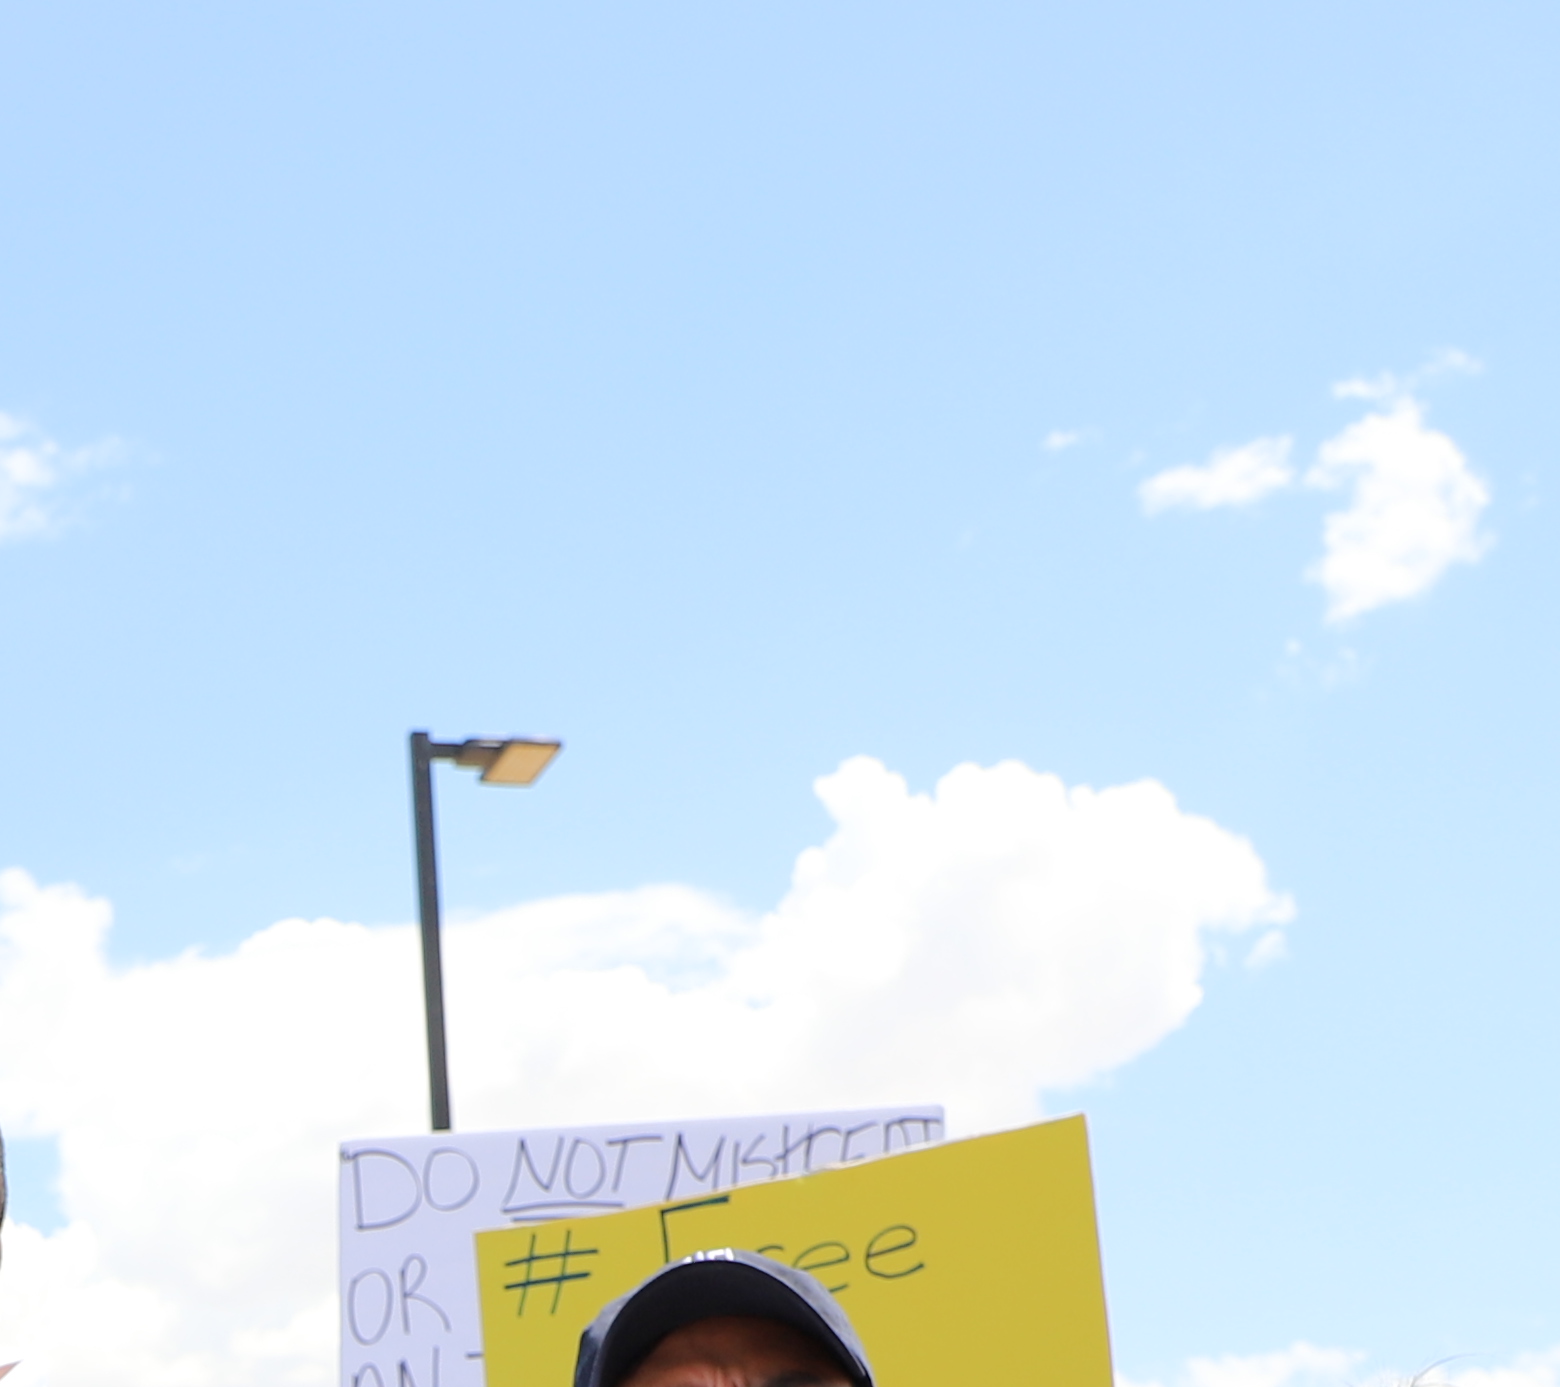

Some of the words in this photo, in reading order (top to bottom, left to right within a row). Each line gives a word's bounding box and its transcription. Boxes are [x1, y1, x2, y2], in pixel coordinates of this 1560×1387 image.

[341, 1145, 481, 1231] DO
[499, 1135, 663, 1208] NOT
[346, 1252, 453, 1347] OR
